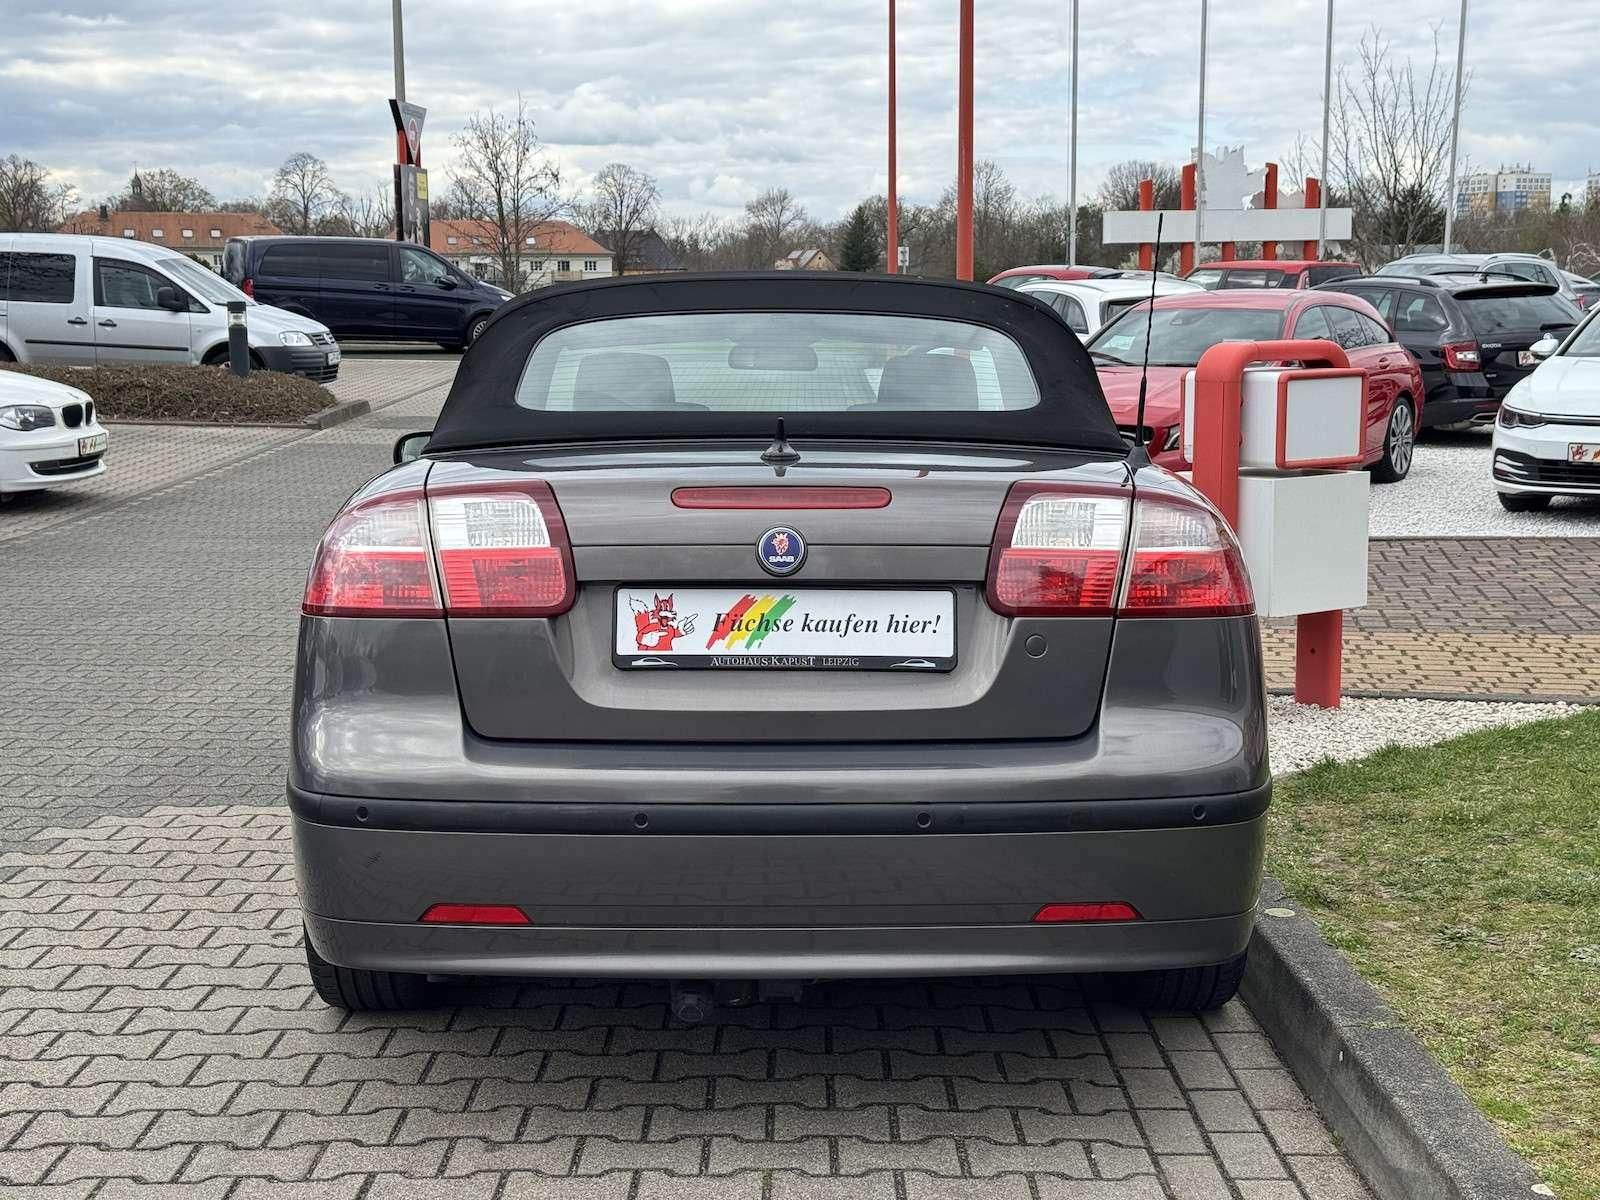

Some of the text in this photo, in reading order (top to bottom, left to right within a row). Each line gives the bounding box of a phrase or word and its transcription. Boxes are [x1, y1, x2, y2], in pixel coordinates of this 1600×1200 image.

[768, 555, 795, 563] SAAB
[712, 612, 941, 637] Füchse kaufen hier!
[822, 657, 859, 666] LEIPZIG
